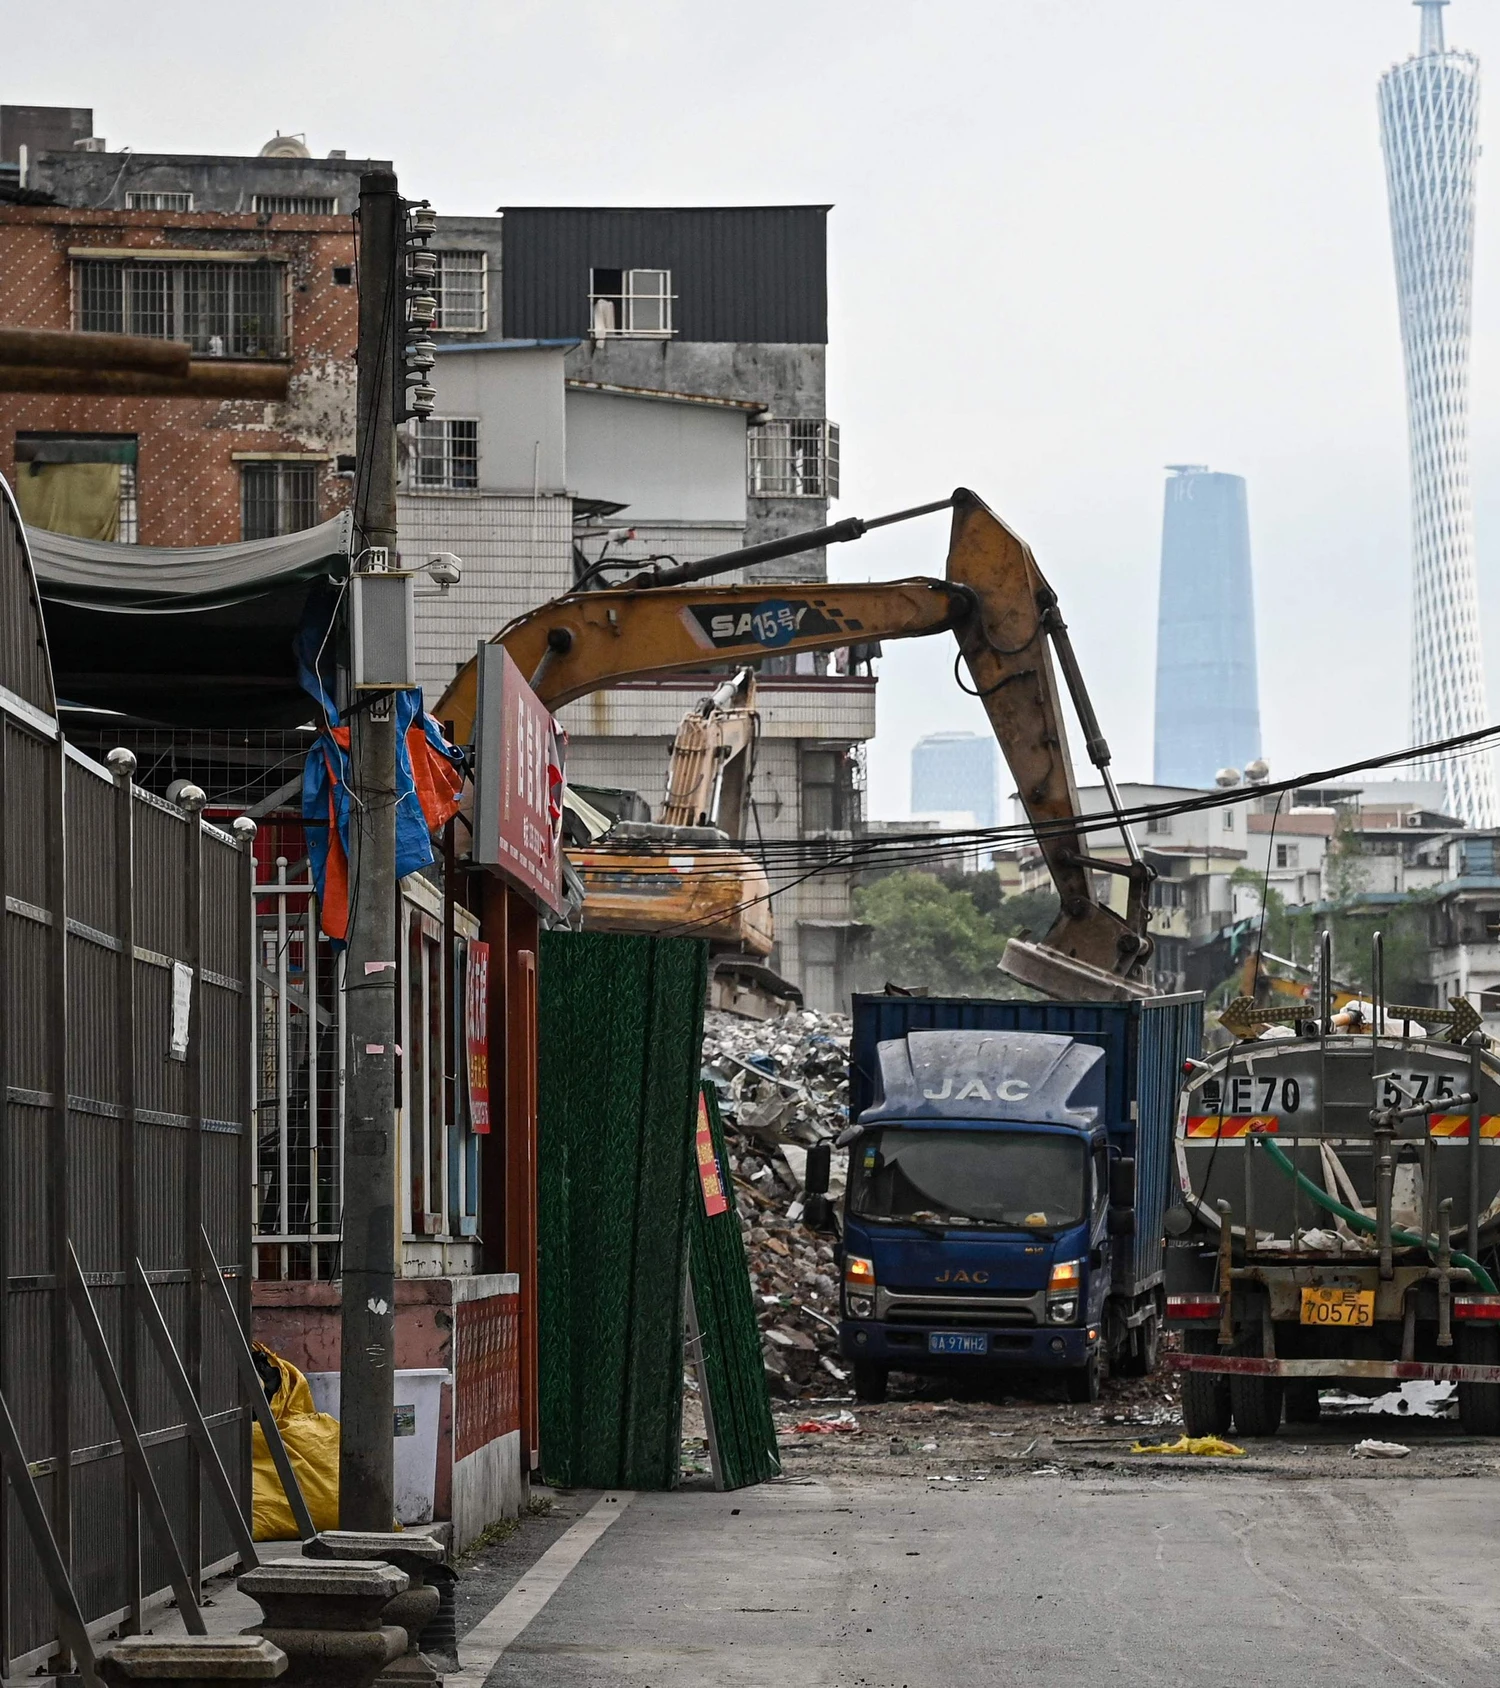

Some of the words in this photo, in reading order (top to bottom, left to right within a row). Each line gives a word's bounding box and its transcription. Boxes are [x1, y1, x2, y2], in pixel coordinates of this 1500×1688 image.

[753, 608, 796, 640] 15号
[923, 1078, 1032, 1101] JAC
[934, 1269, 989, 1284] JAC
[1305, 1300, 1369, 1324] 70575
